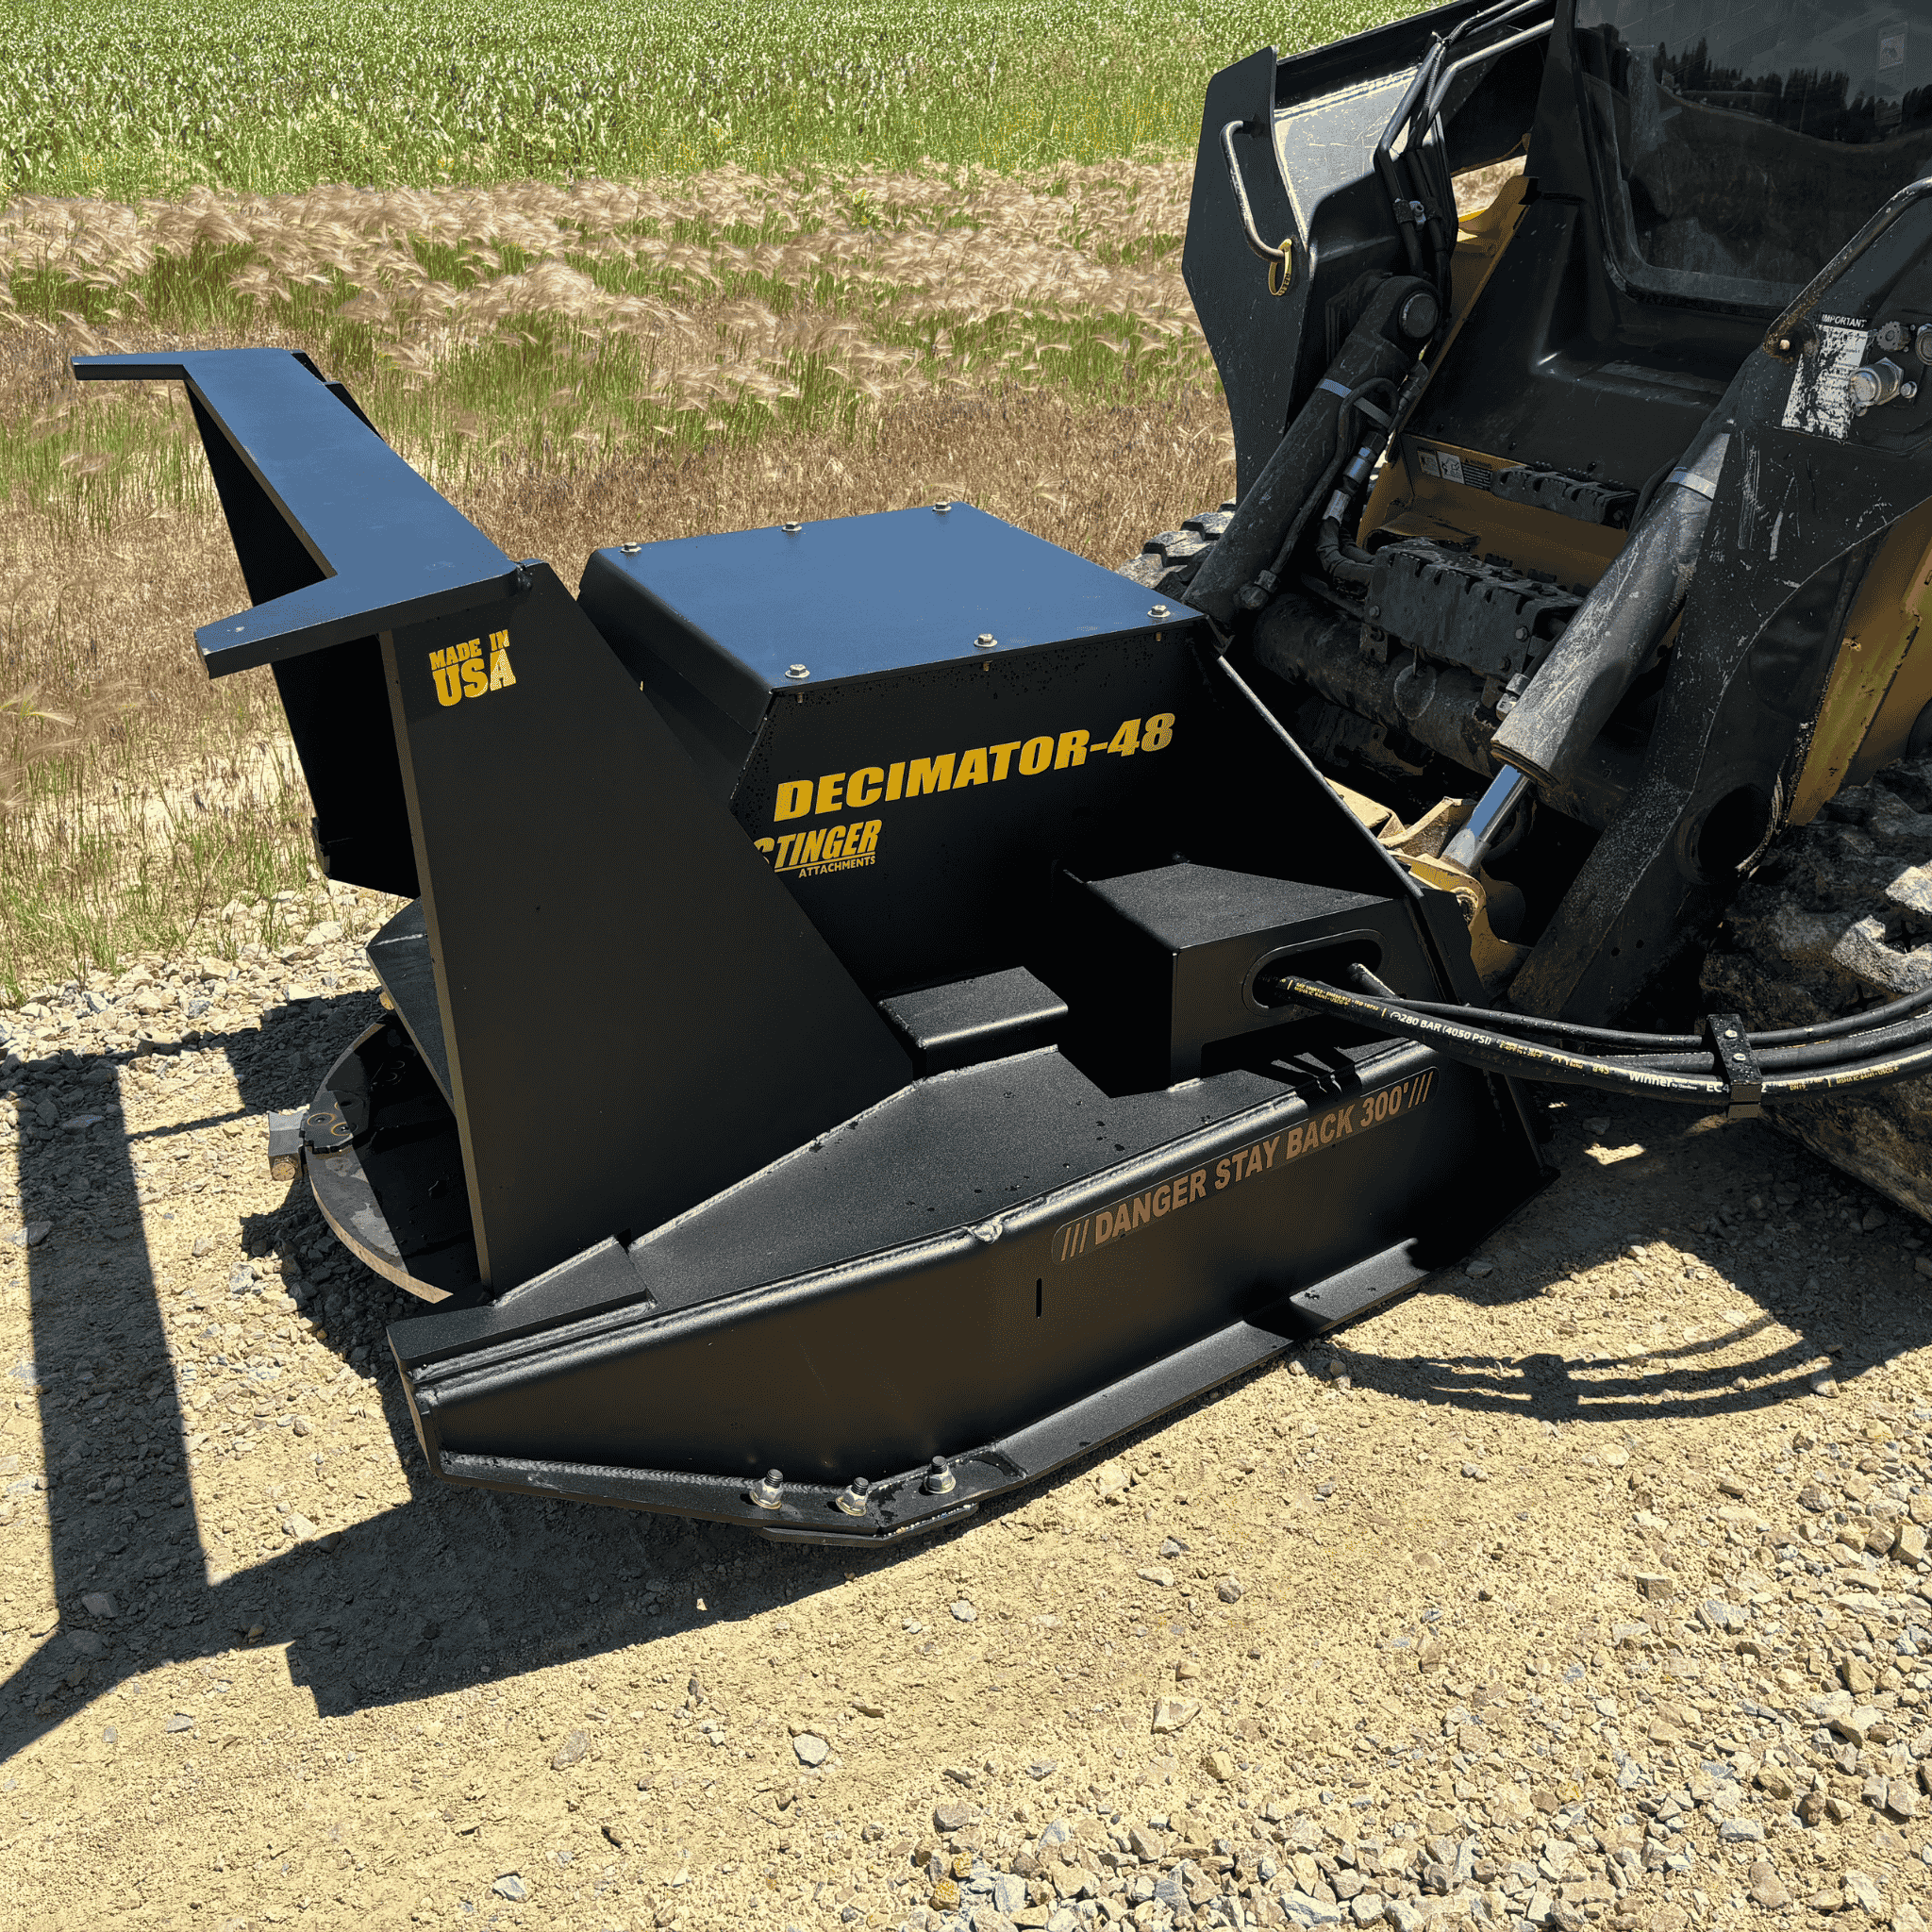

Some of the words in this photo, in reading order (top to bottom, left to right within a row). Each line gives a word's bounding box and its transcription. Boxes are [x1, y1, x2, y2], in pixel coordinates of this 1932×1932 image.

[1822, 314, 1867, 327] IMPORTANT
[429, 638, 482, 671] MADE
[489, 629, 509, 651] IN
[432, 648, 516, 707] USA
[774, 712, 1176, 823] DECIMATOR-48
[798, 855, 876, 878] ATTACHMENTS
[1399, 1013, 1419, 1025] 280
[1420, 1020, 1442, 1032] BAR
[1442, 1024, 1472, 1040] (4050
[1472, 1033, 1492, 1045] PSI)
[1629, 1071, 1672, 1088] Winner
[1095, 1169, 1208, 1246] DANGER
[1214, 1136, 1281, 1191] STAY
[1286, 1104, 1356, 1160] BACK
[1359, 1082, 1409, 1127] 300'
